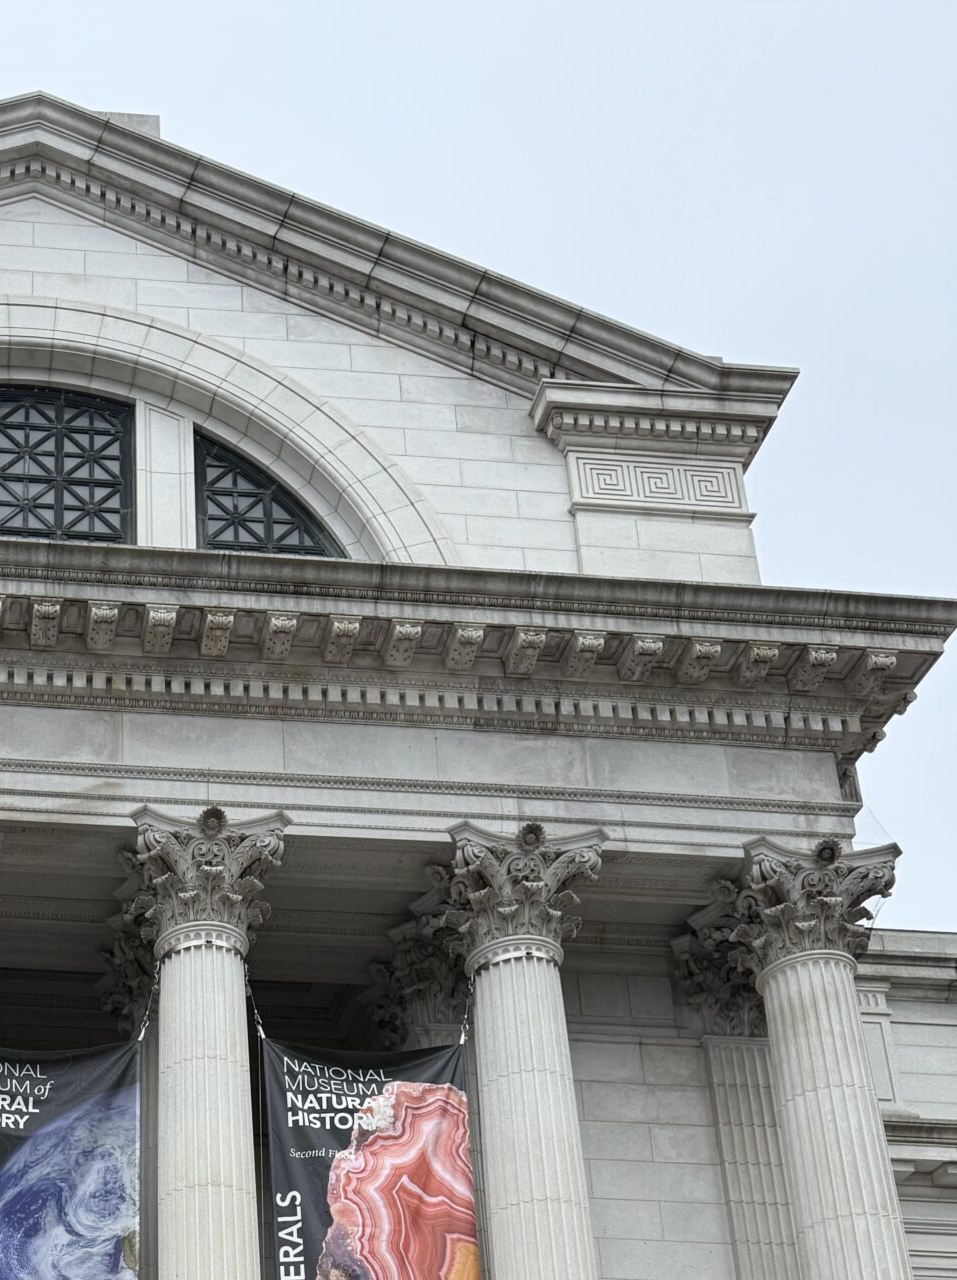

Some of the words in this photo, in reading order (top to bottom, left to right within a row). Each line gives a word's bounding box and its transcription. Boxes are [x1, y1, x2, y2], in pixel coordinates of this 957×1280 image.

[283, 1056, 393, 1082] NATIONAL
[34, 1081, 54, 1100] of
[285, 1074, 378, 1096] MUSEUM
[286, 1091, 391, 1111] NATURA
[289, 1148, 326, 1159] Second
